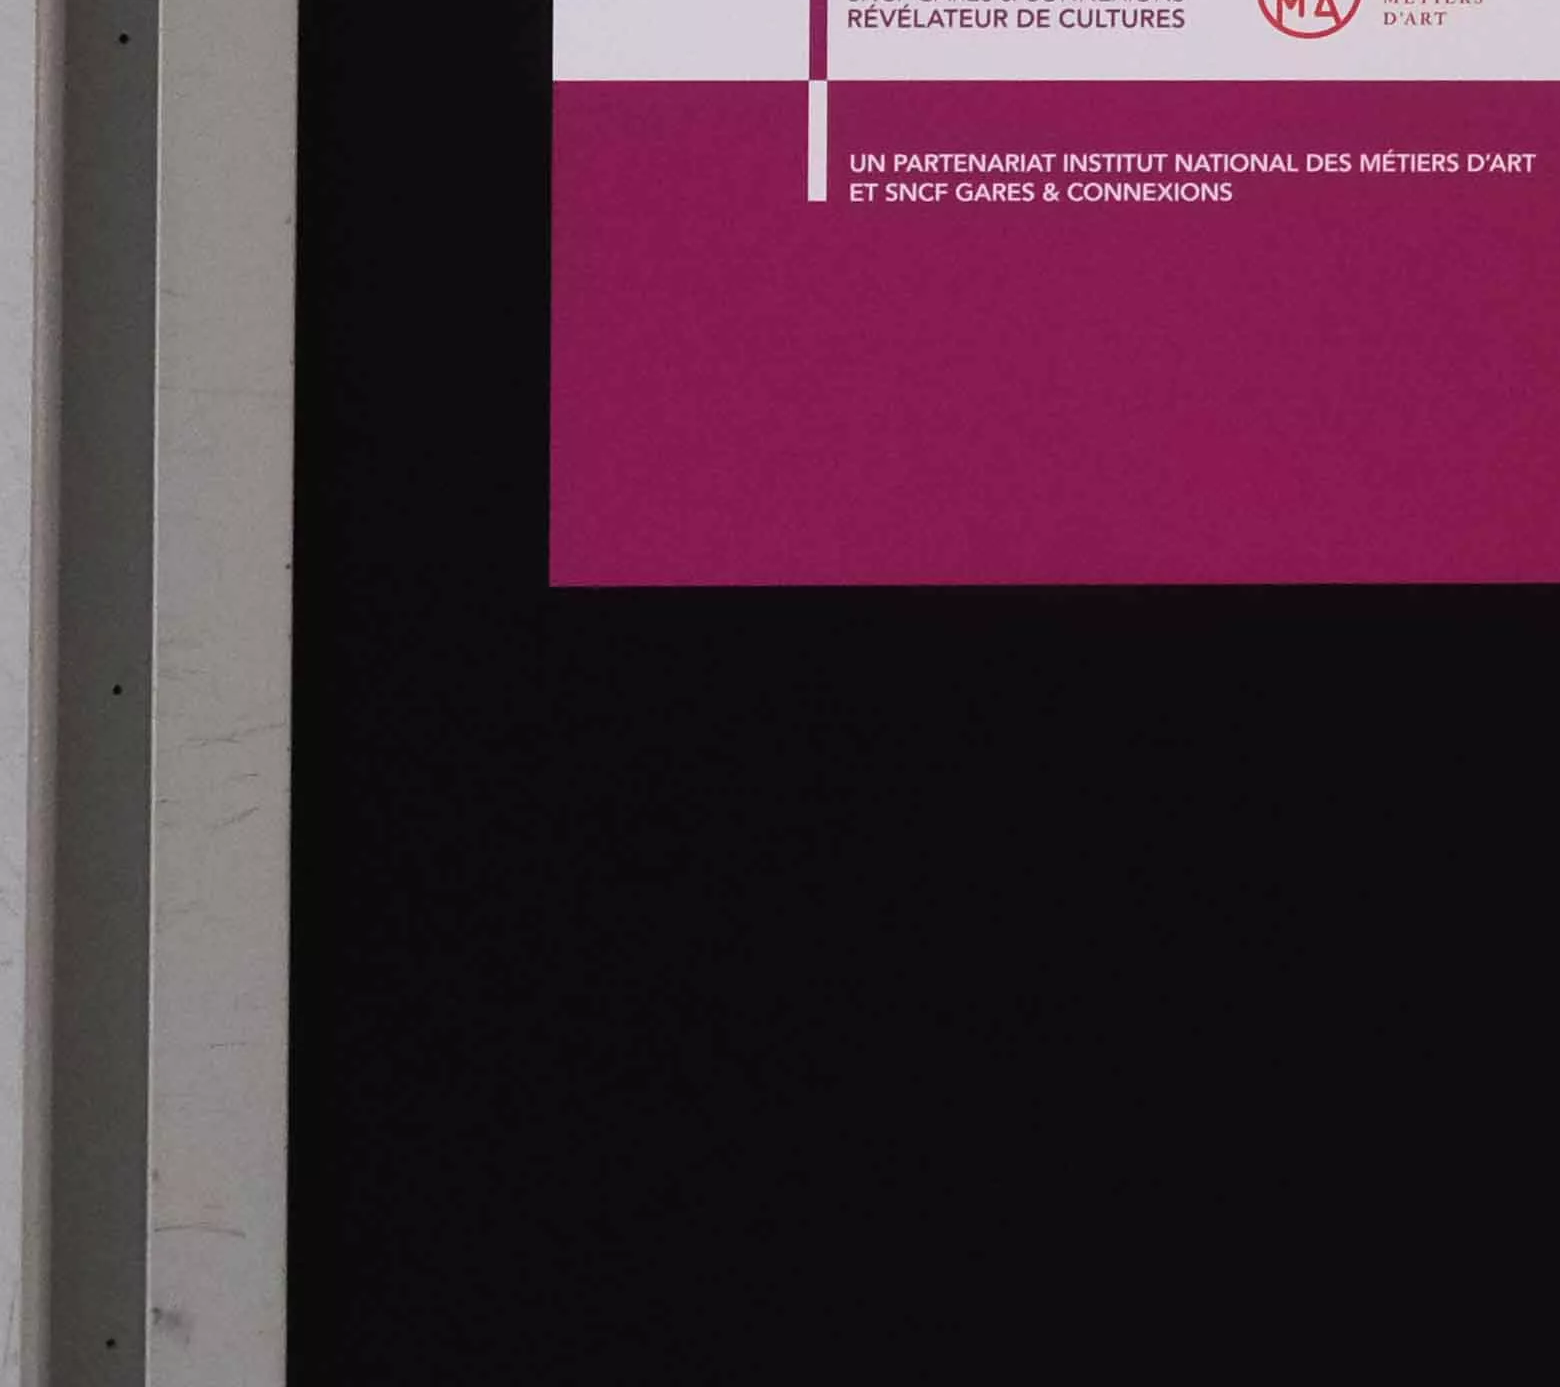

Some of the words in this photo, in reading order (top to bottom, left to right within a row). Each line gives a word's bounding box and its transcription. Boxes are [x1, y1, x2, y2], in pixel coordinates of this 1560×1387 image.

[848, 3, 1008, 28] RÉVÉLATEUR
[1017, 9, 1050, 28] DE
[1059, 8, 1185, 29] CULTURES
[1384, 11, 1447, 26] D'ART
[850, 153, 885, 173] UN
[894, 153, 1056, 172] PARTENARIAT
[1064, 153, 1168, 173] INSTITUT
[1175, 153, 1299, 173] NATIONAL
[1307, 153, 1352, 172] DES
[1360, 149, 1459, 173] MÉTIERS
[1468, 153, 1536, 173] D'ART
[850, 183, 879, 202] ET
[885, 183, 948, 202] SNCF
[955, 182, 1035, 202] GARES
[1043, 182, 1060, 202] &
[1067, 182, 1232, 202] CONNEXIONS
